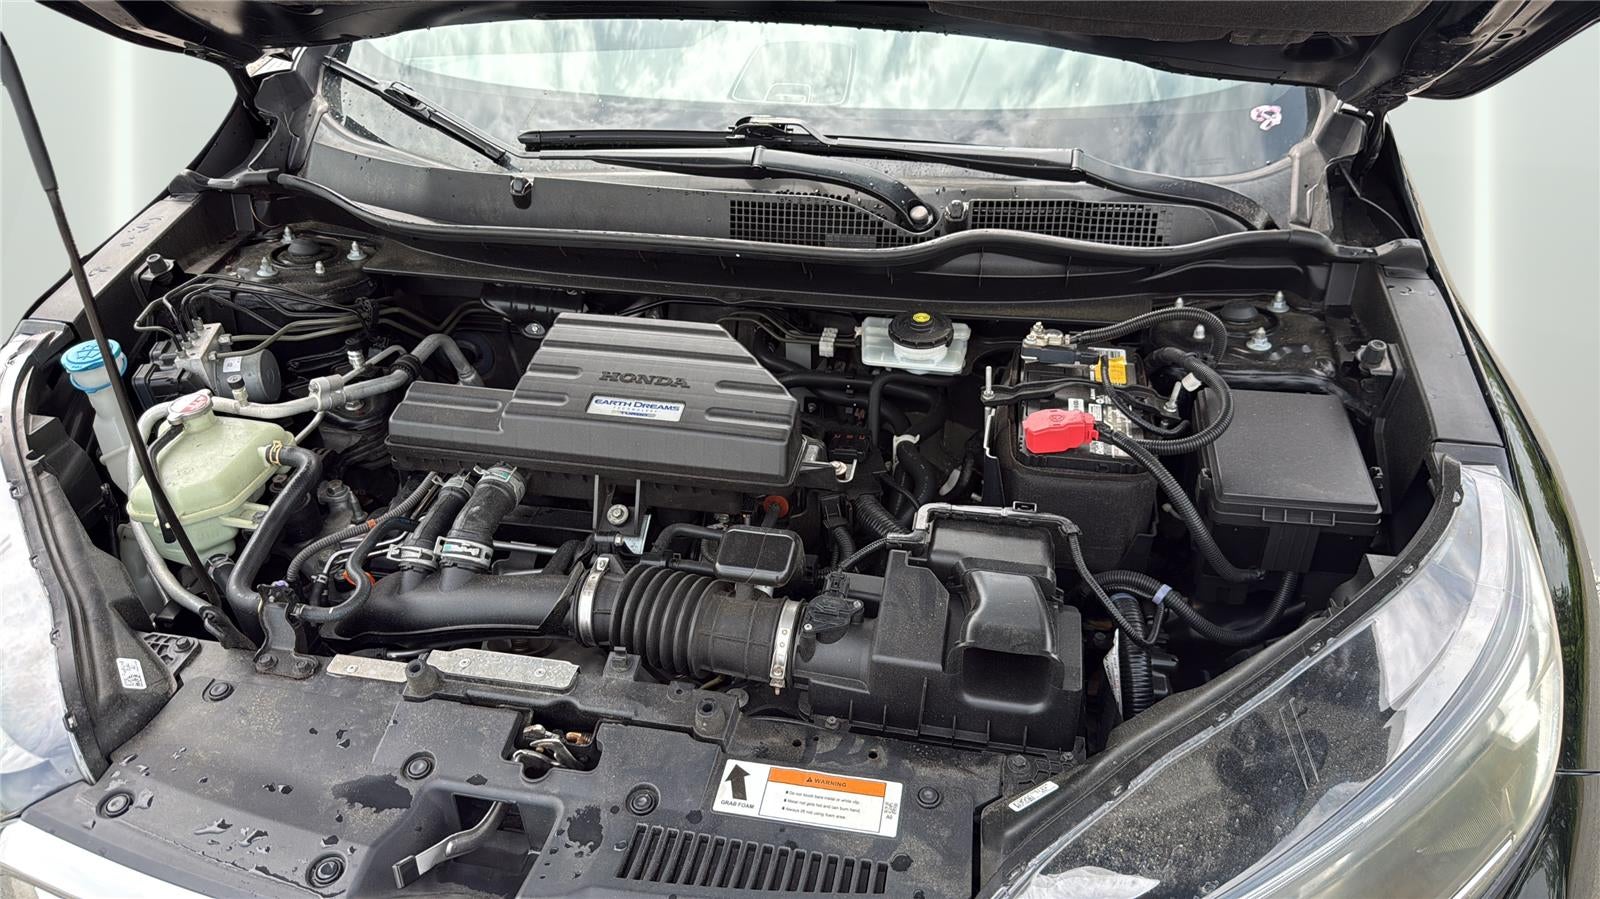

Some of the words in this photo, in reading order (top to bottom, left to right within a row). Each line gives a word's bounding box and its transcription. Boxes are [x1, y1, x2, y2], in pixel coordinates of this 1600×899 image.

[599, 371, 690, 389] HONDA
[594, 399, 632, 408] EARTH
[633, 401, 680, 412] DREAMS
[814, 778, 847, 787] WARNING
[720, 799, 737, 807] GRAB
[737, 801, 755, 809] FOAM
